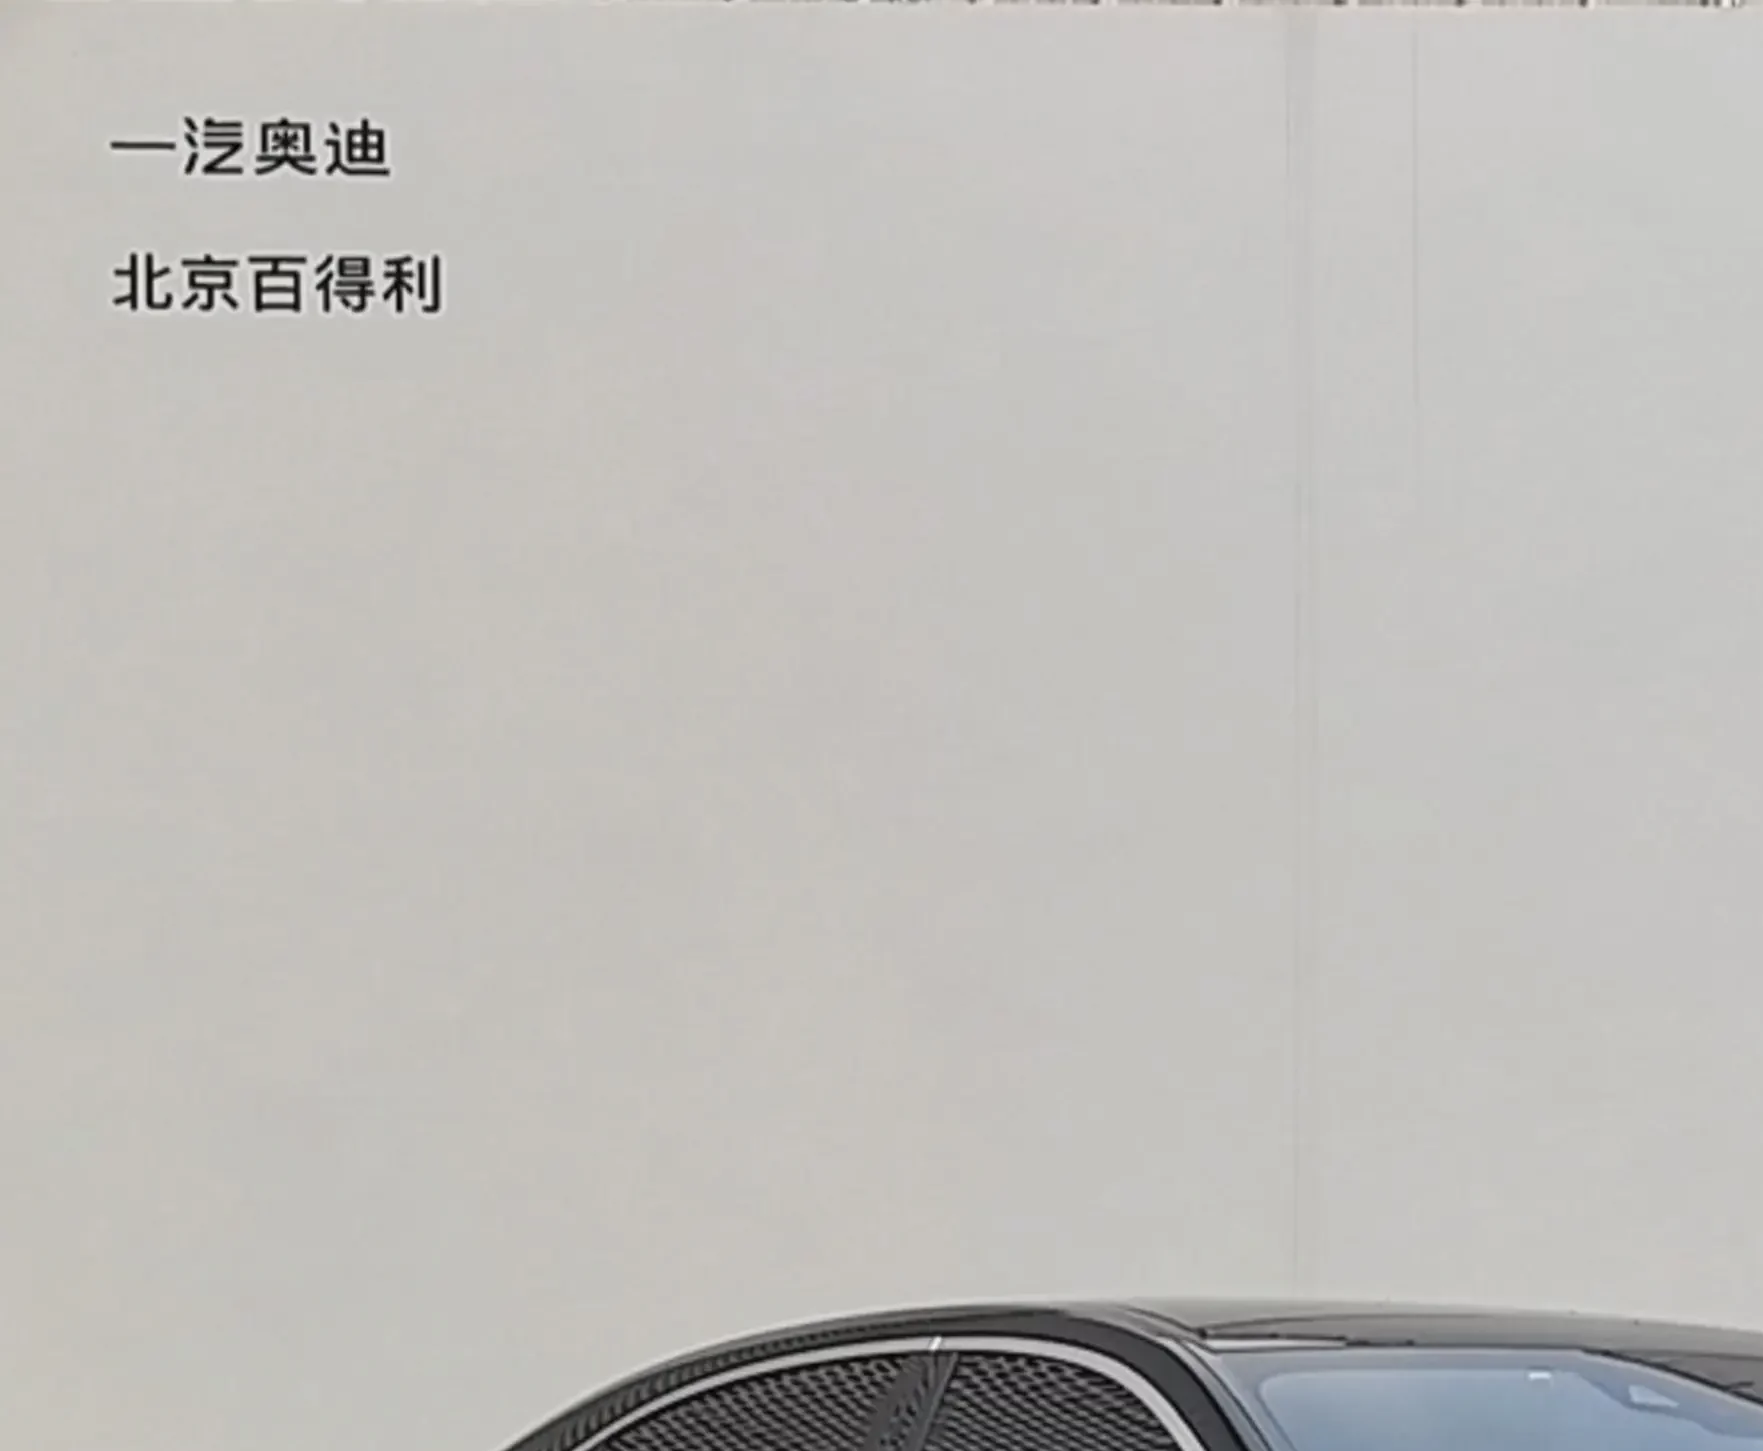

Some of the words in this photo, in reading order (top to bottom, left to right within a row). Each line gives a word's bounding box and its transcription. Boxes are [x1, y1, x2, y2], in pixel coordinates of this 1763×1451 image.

[110, 117, 390, 176] 一汽奥迪
[112, 252, 441, 313] 北京百得利
